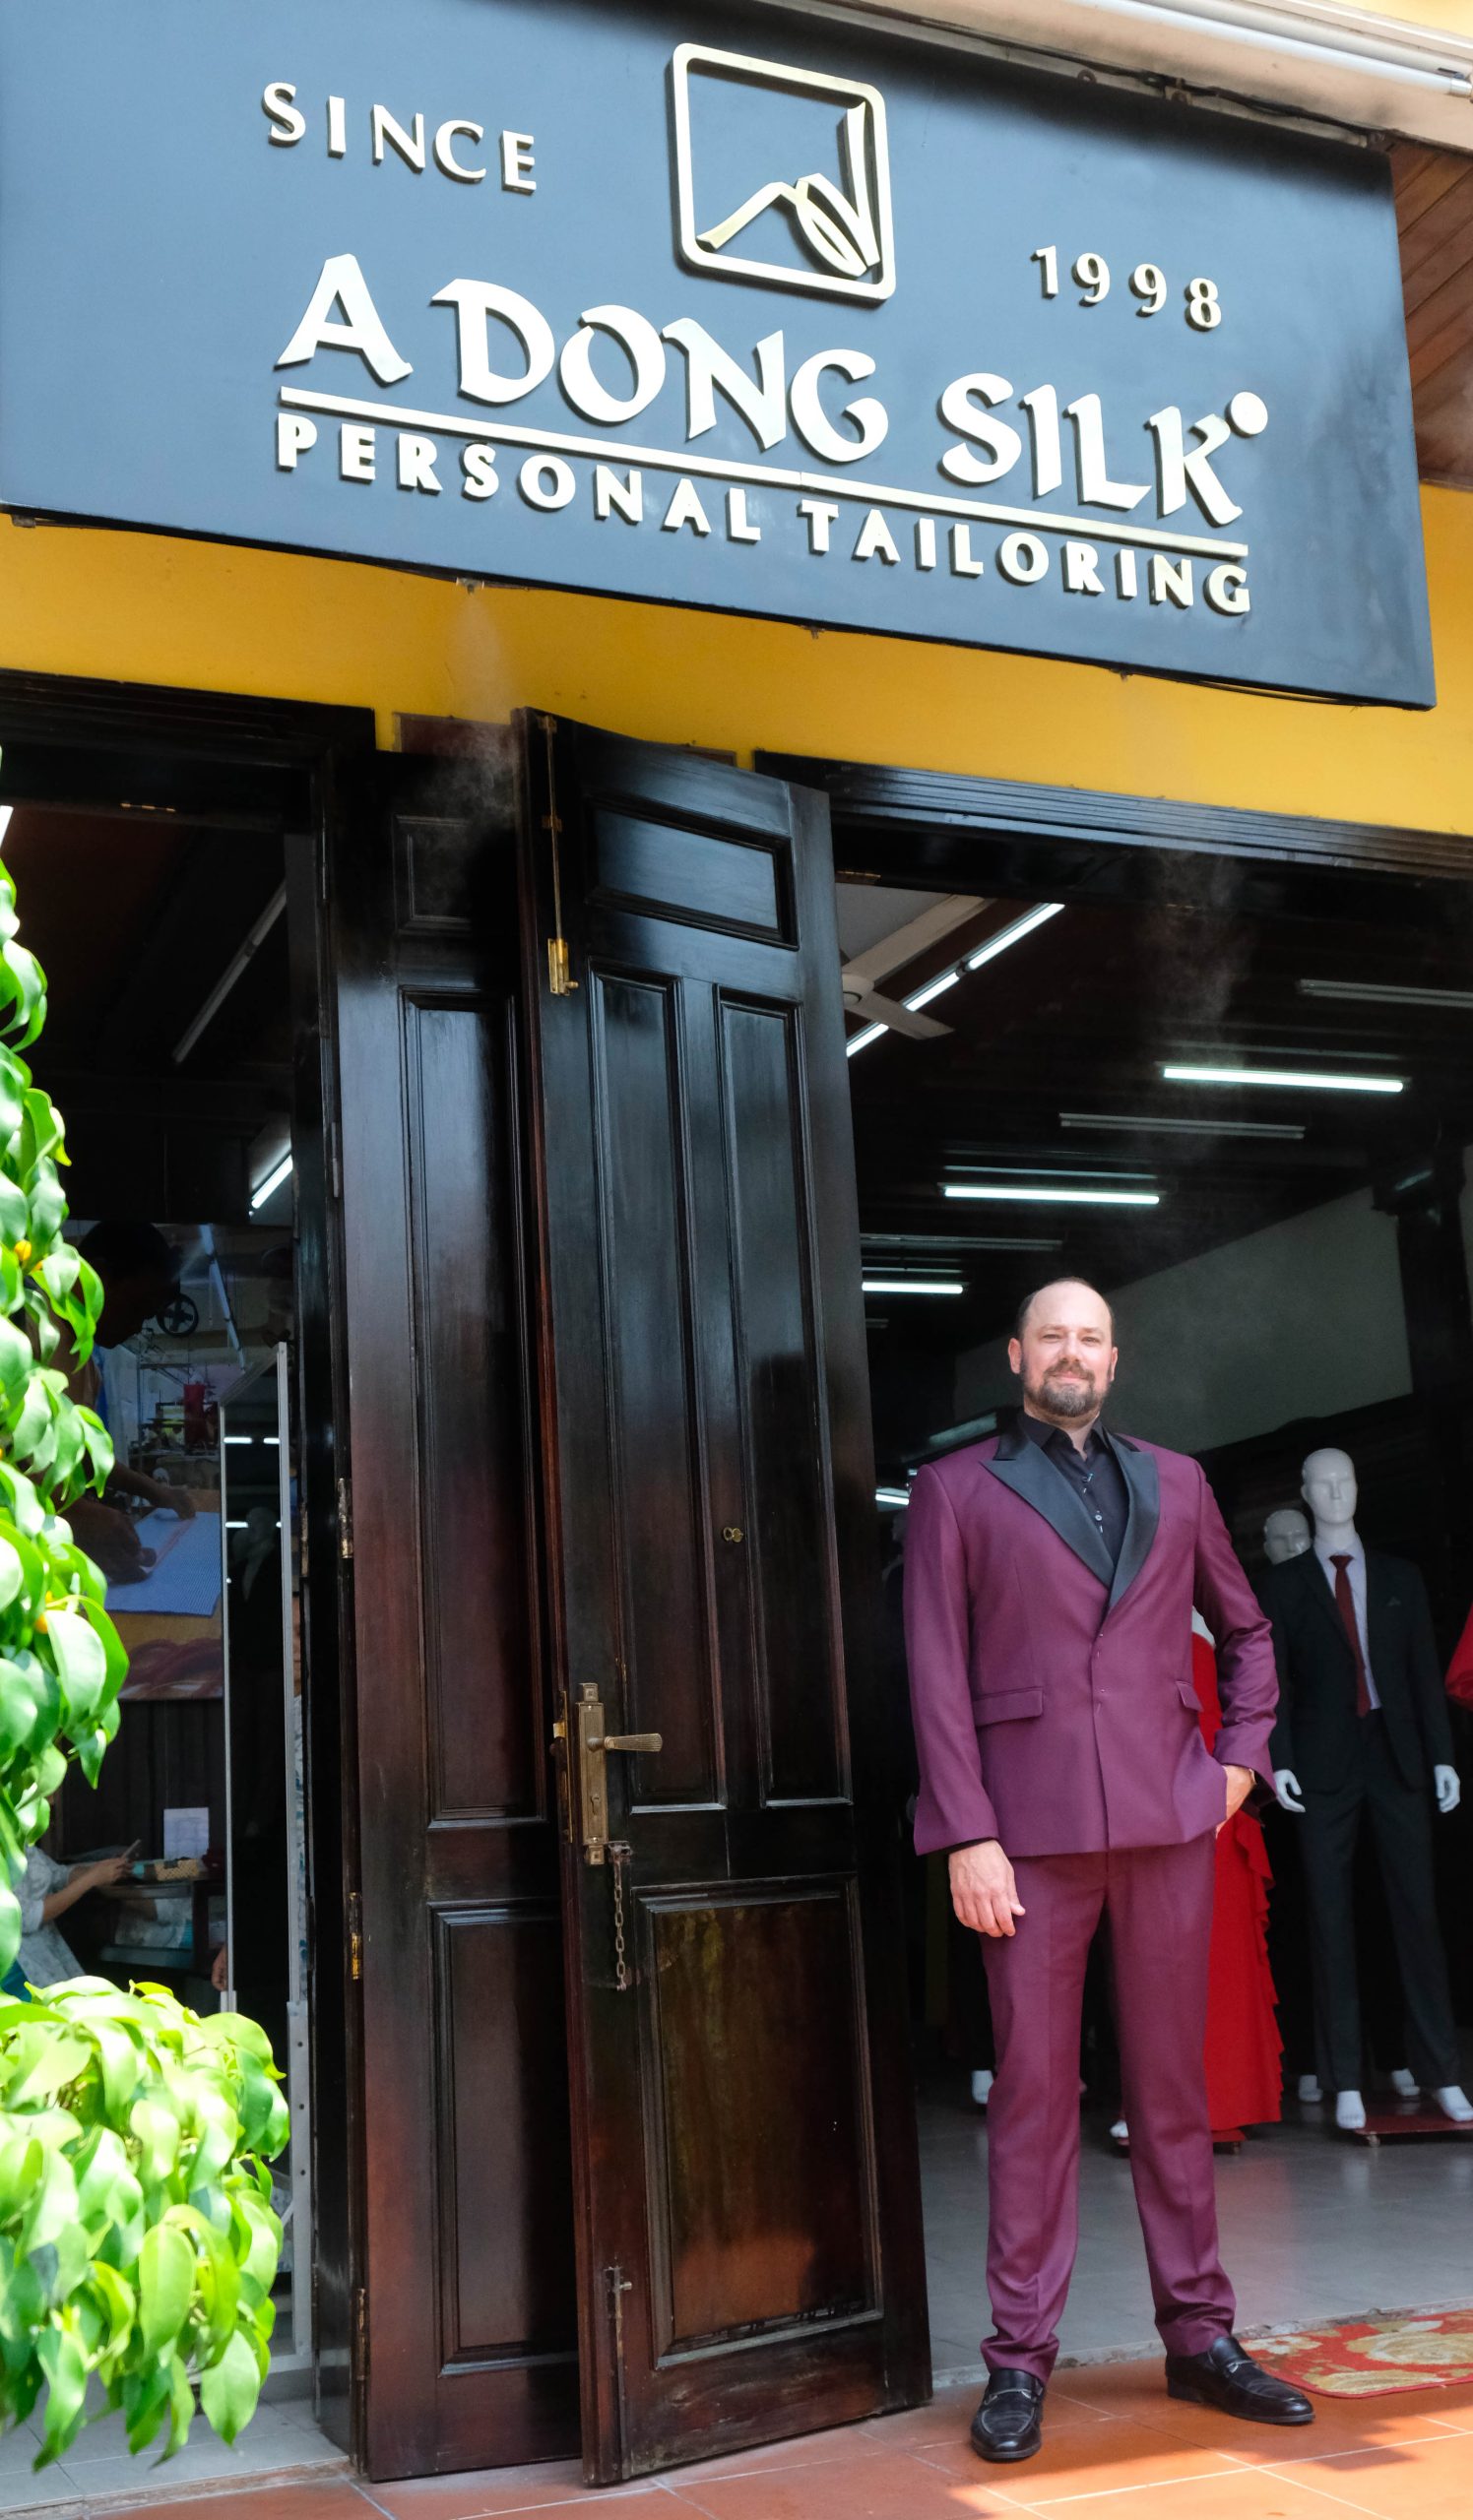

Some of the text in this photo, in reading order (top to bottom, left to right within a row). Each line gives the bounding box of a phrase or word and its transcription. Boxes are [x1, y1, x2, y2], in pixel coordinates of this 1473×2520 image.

[261, 81, 538, 195] SINCE
[1032, 244, 1222, 332] 1998
[274, 253, 1268, 528] A DONG SILK
[276, 411, 1251, 615] PERSONAL TAILORING
